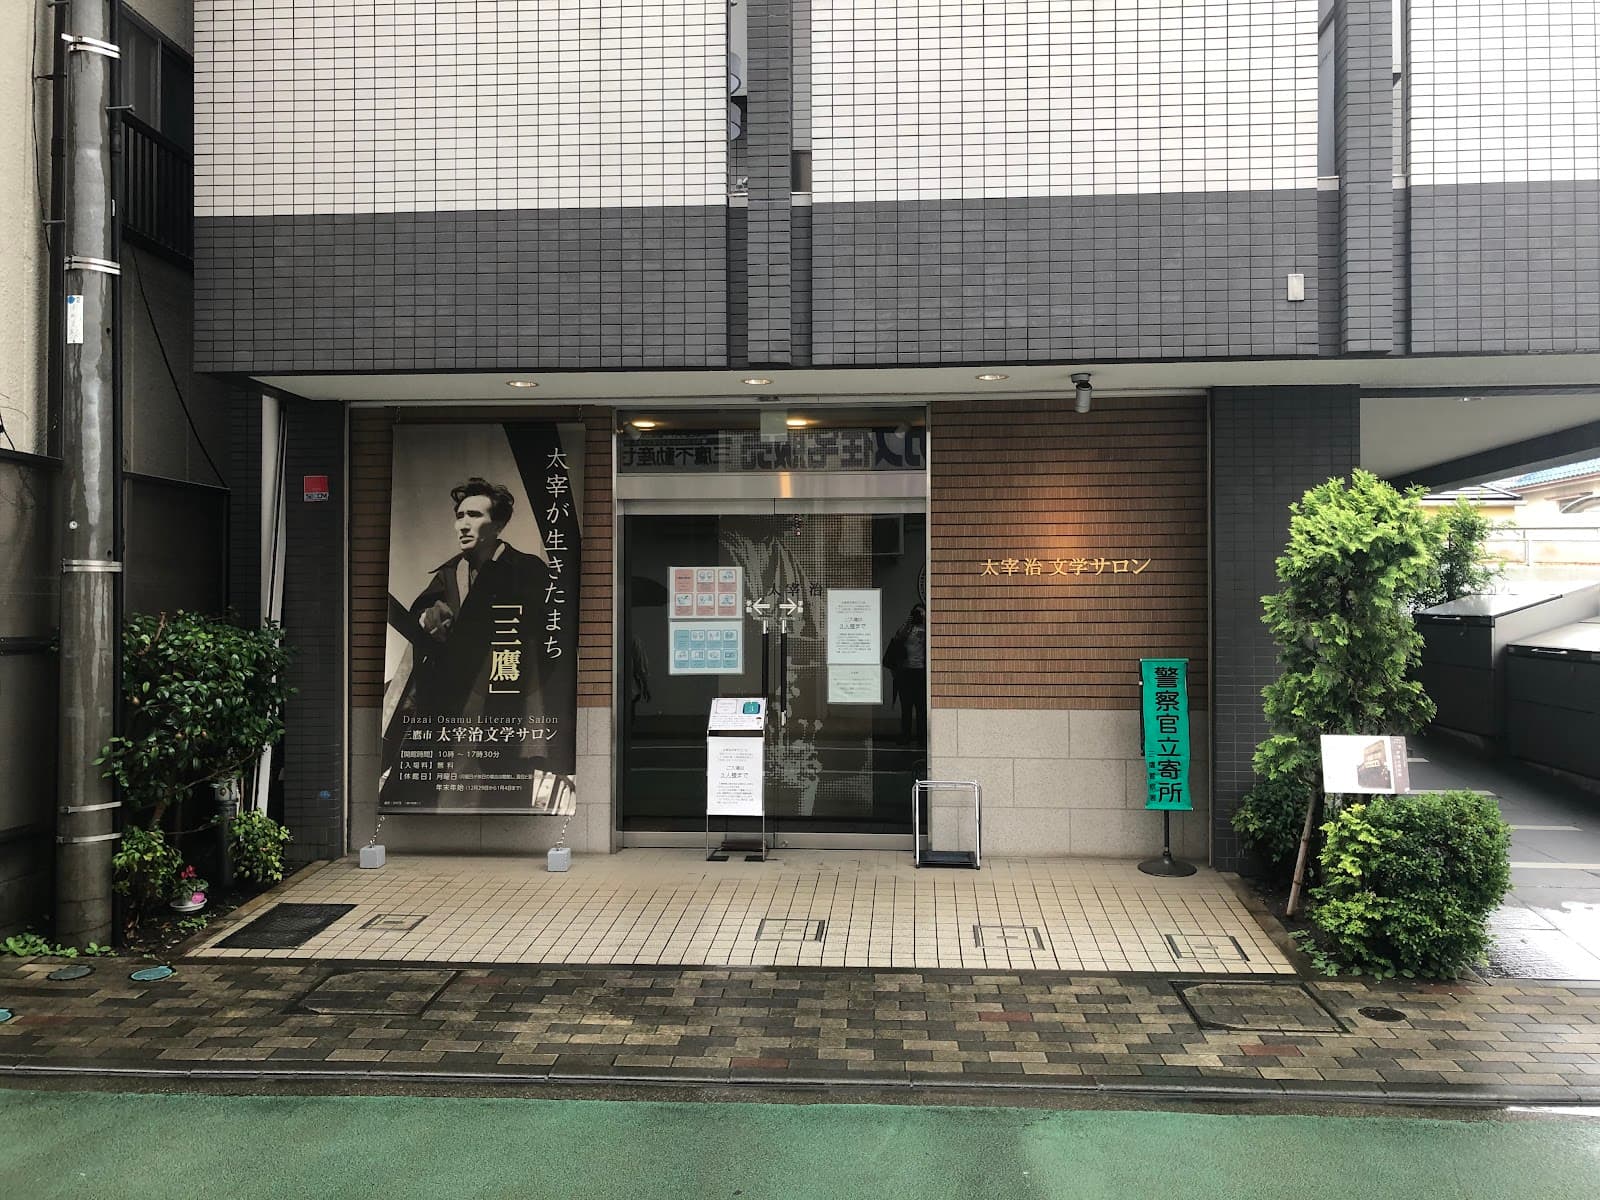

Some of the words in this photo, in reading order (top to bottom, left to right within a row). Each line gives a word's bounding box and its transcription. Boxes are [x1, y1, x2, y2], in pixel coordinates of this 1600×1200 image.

[544, 447, 570, 660] 太宰が生きたまち
[981, 557, 1042, 577] 太宰治
[1049, 557, 1152, 577] 文学サロン
[489, 604, 523, 695] 「三鷹」
[403, 715, 432, 724] Dazai
[437, 715, 472, 724] Osamu
[477, 715, 522, 725] Literary
[528, 715, 558, 724] Salon
[403, 730, 432, 741] 三鷹市
[436, 726, 558, 743] 太宰治文学サロン
[1154, 666, 1183, 803] 警察官立寄所
[467, 750, 500, 759] 17時30分
